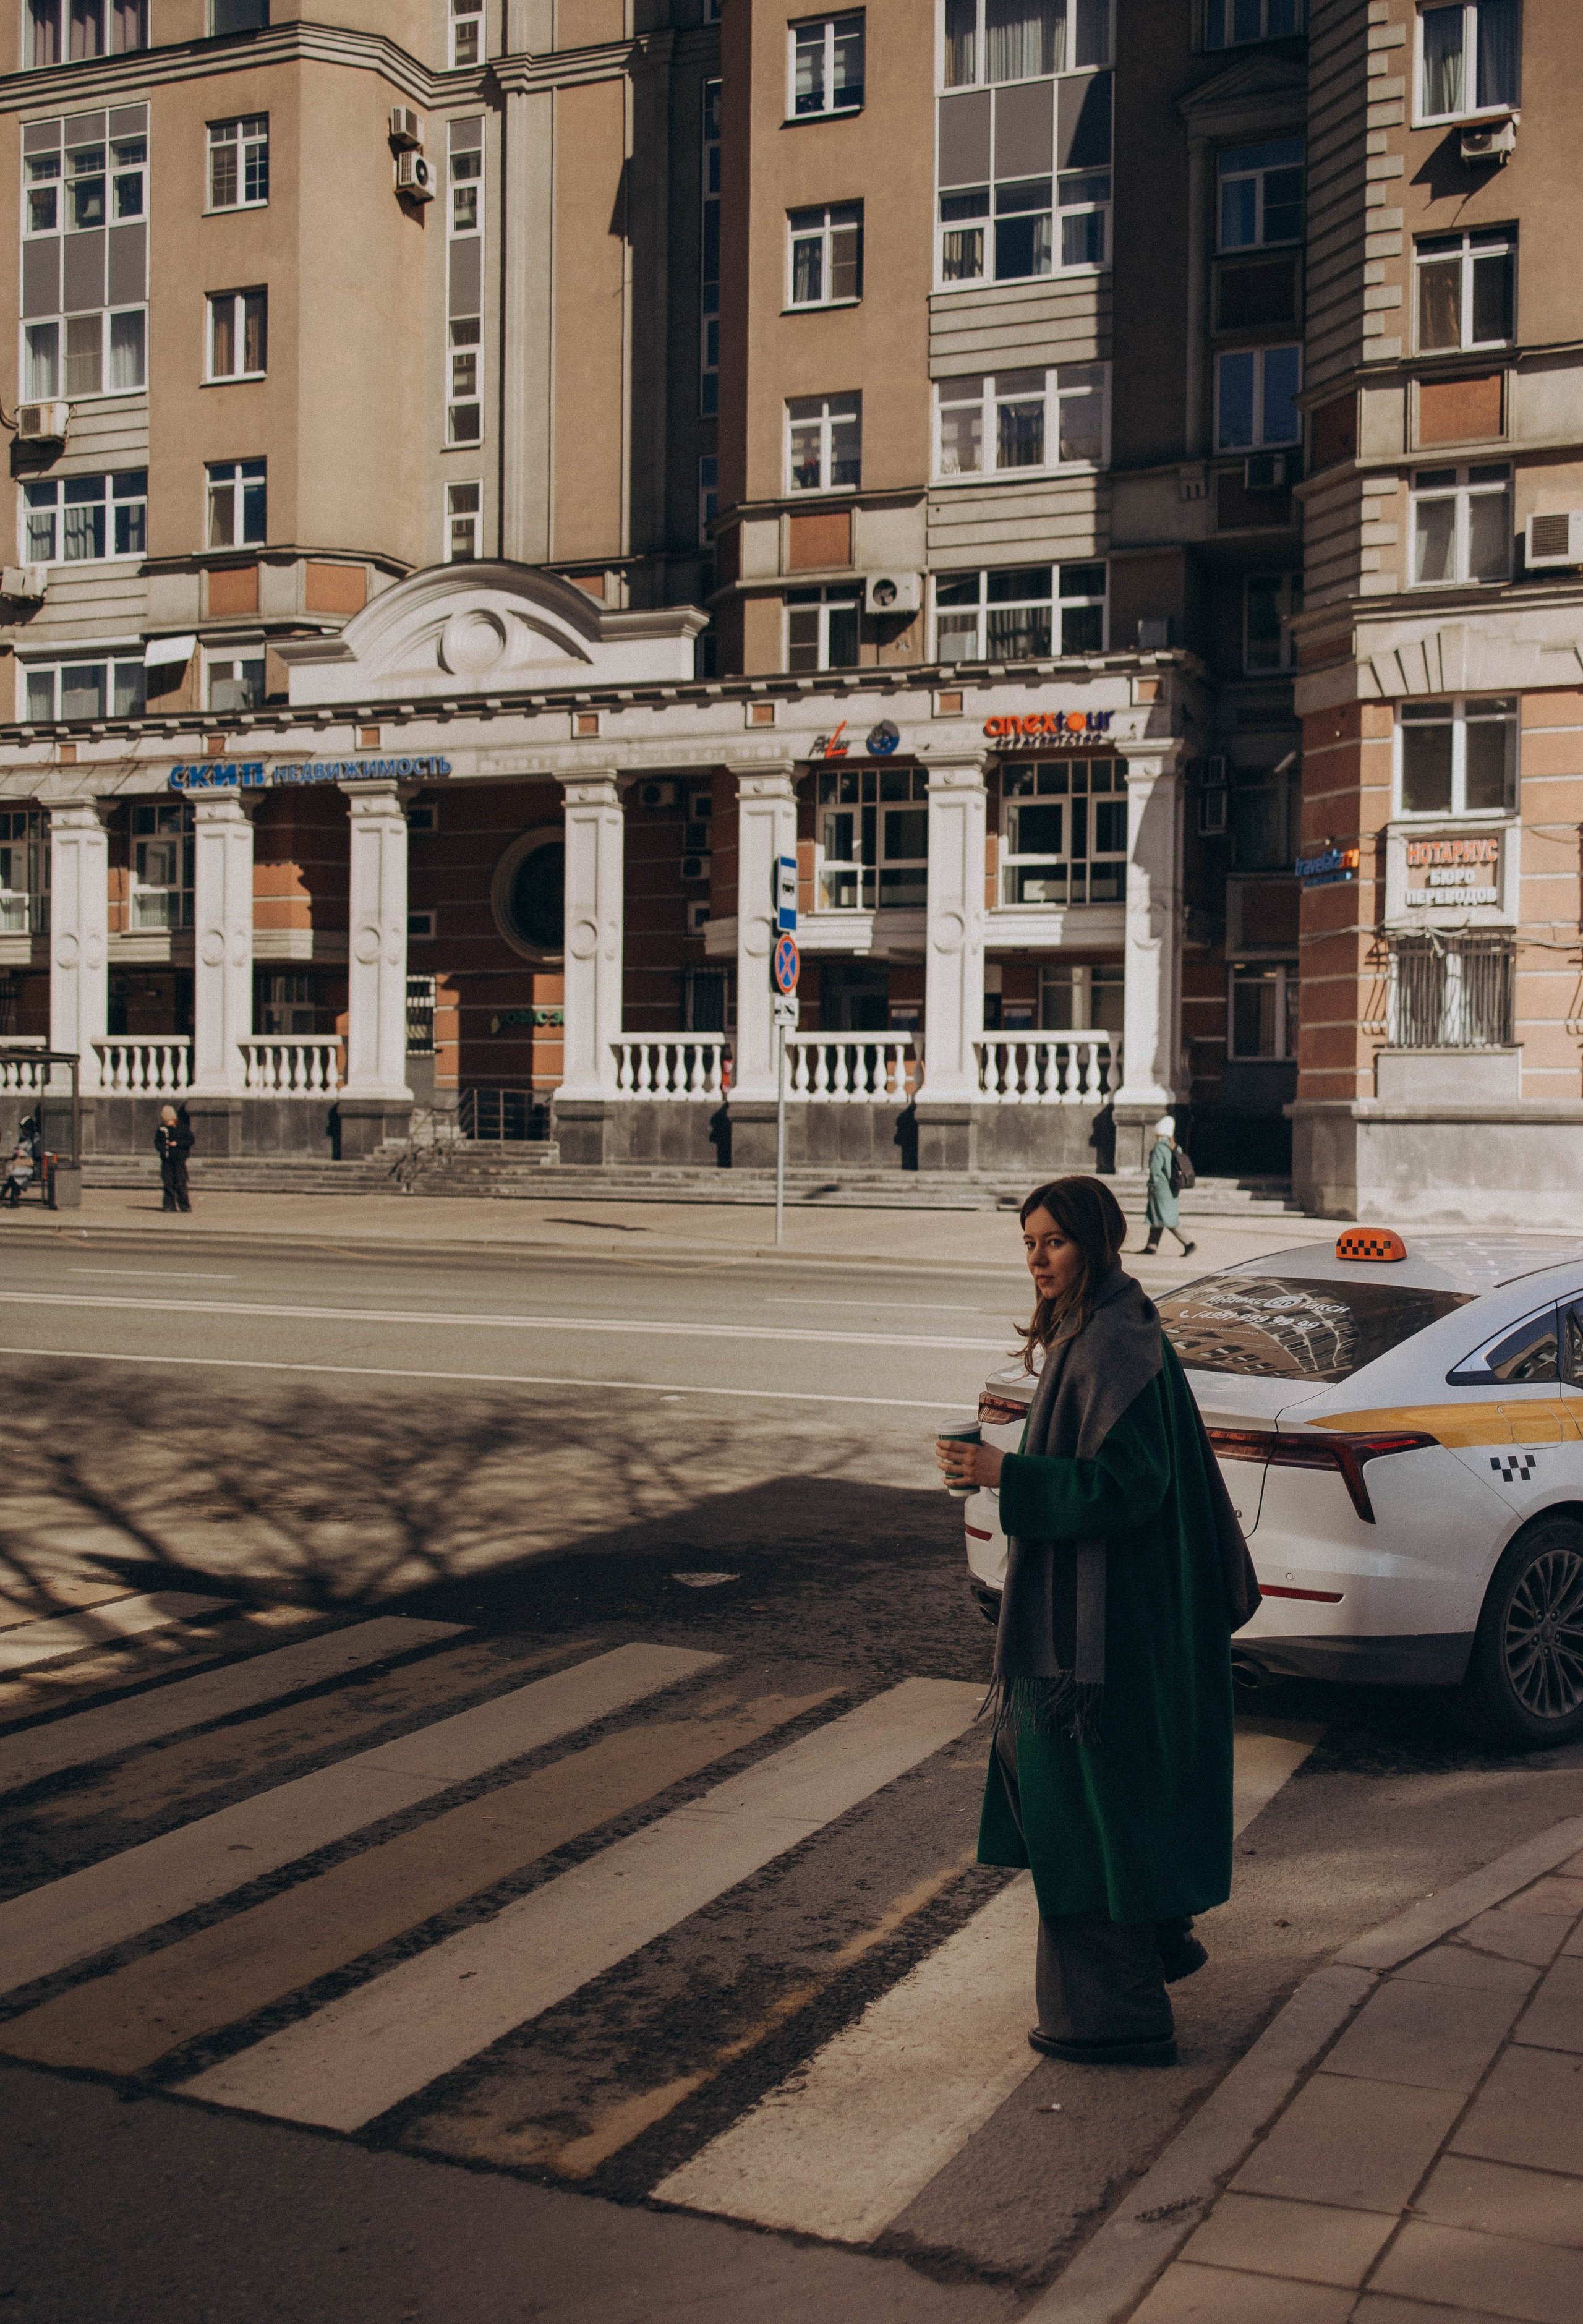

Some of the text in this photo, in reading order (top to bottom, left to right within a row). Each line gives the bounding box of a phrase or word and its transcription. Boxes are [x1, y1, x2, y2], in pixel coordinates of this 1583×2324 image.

[985, 711, 1116, 736] anextour
[169, 761, 266, 789] СКИП
[274, 756, 452, 784] НЕДВИЖИМОСТЬ
[1407, 839, 1498, 865] НОТАРИУС
[1430, 868, 1476, 886] БЮРО
[1406, 886, 1497, 906] ПЕРЕВОДОВ
[1209, 1294, 1268, 1305] Яндекс
[1299, 1300, 1350, 1314] Такси
[1191, 1310, 1320, 1330] (495) 999 99 99
